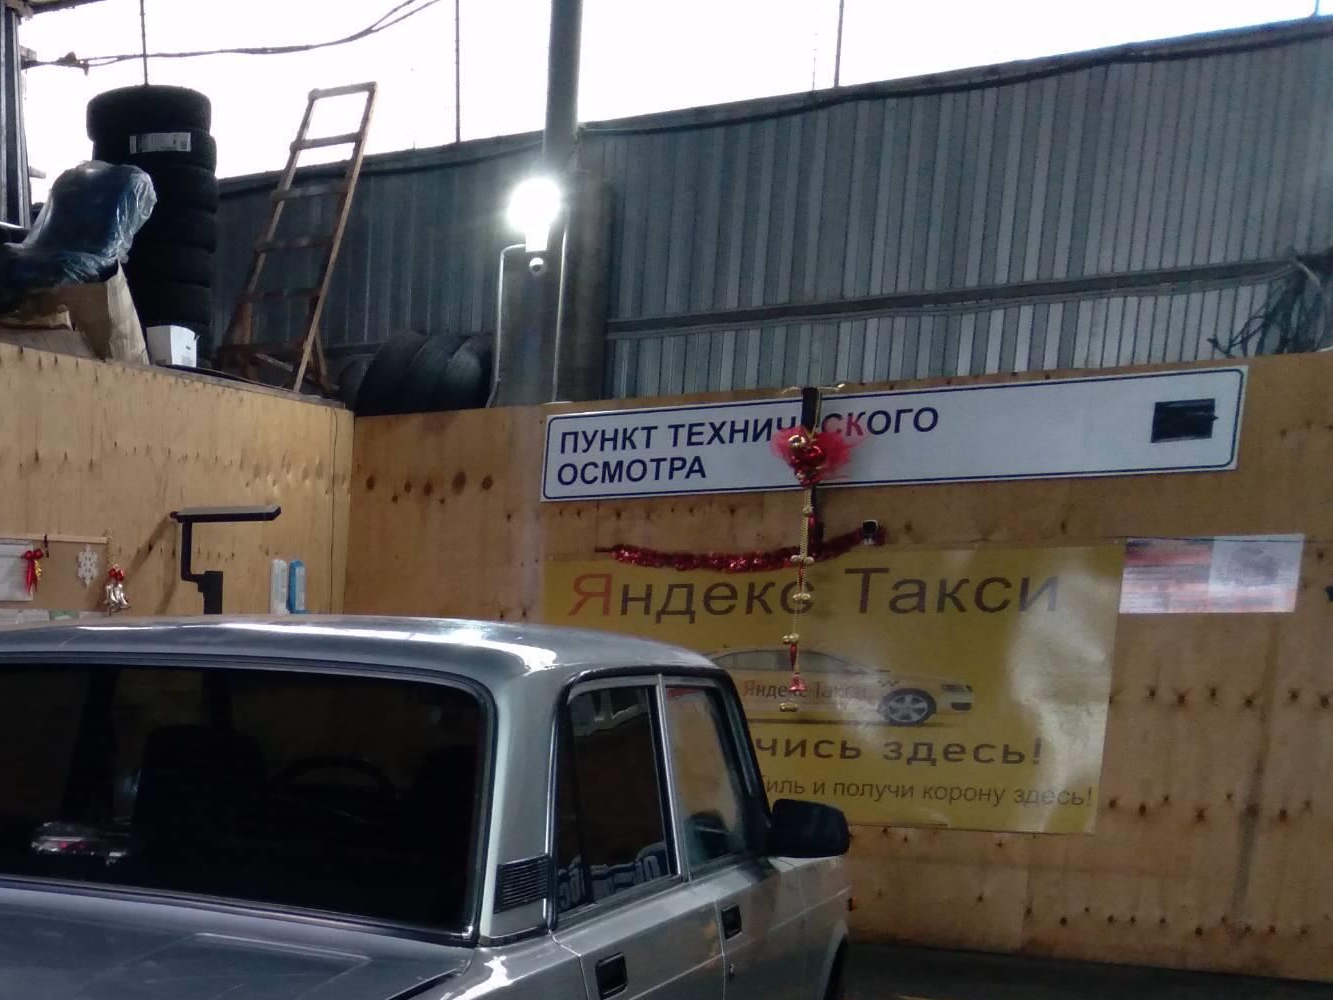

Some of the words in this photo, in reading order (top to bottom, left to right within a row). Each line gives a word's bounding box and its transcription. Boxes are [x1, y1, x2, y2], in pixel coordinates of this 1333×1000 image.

[559, 426, 658, 455] ПУНКТ
[666, 406, 940, 447] ТЕХНИЧСКОГО
[557, 455, 707, 486] ОСМОТРА
[567, 572, 814, 625] Яндекс
[844, 566, 1060, 616] Такси
[741, 680, 809, 700] Яндес
[882, 736, 1043, 767] здесь!
[761, 774, 805, 796] иль
[812, 780, 825, 796] и
[834, 782, 915, 804] получи
[923, 784, 1006, 806] корону
[1013, 785, 1093, 808] здесь!
